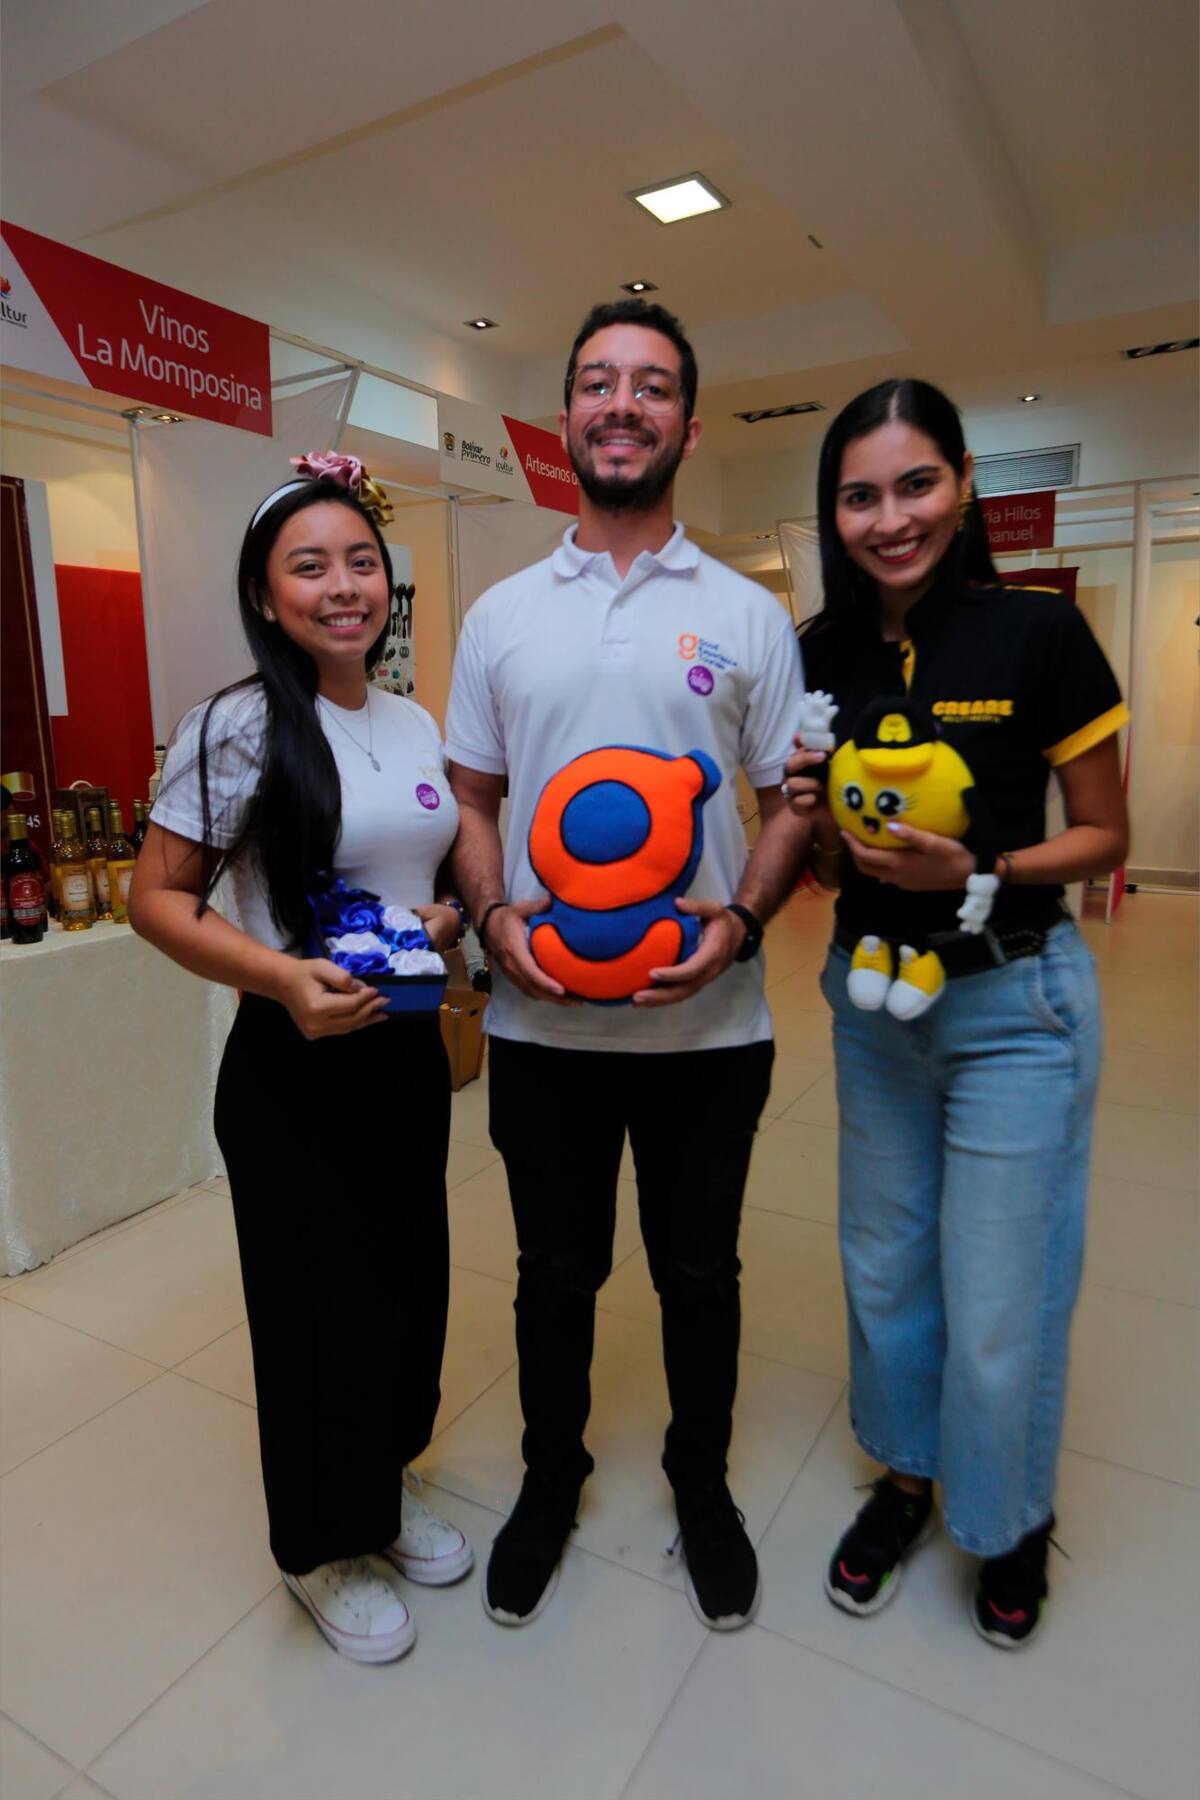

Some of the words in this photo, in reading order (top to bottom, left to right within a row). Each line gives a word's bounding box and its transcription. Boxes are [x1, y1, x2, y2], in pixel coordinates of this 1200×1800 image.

[138, 299, 210, 353] Vinos
[78, 323, 113, 367] La
[120, 337, 262, 411] Momposina
[525, 453, 571, 484] Artesanos
[1004, 505, 1042, 522] Hilos
[932, 699, 1013, 716] CREARE
